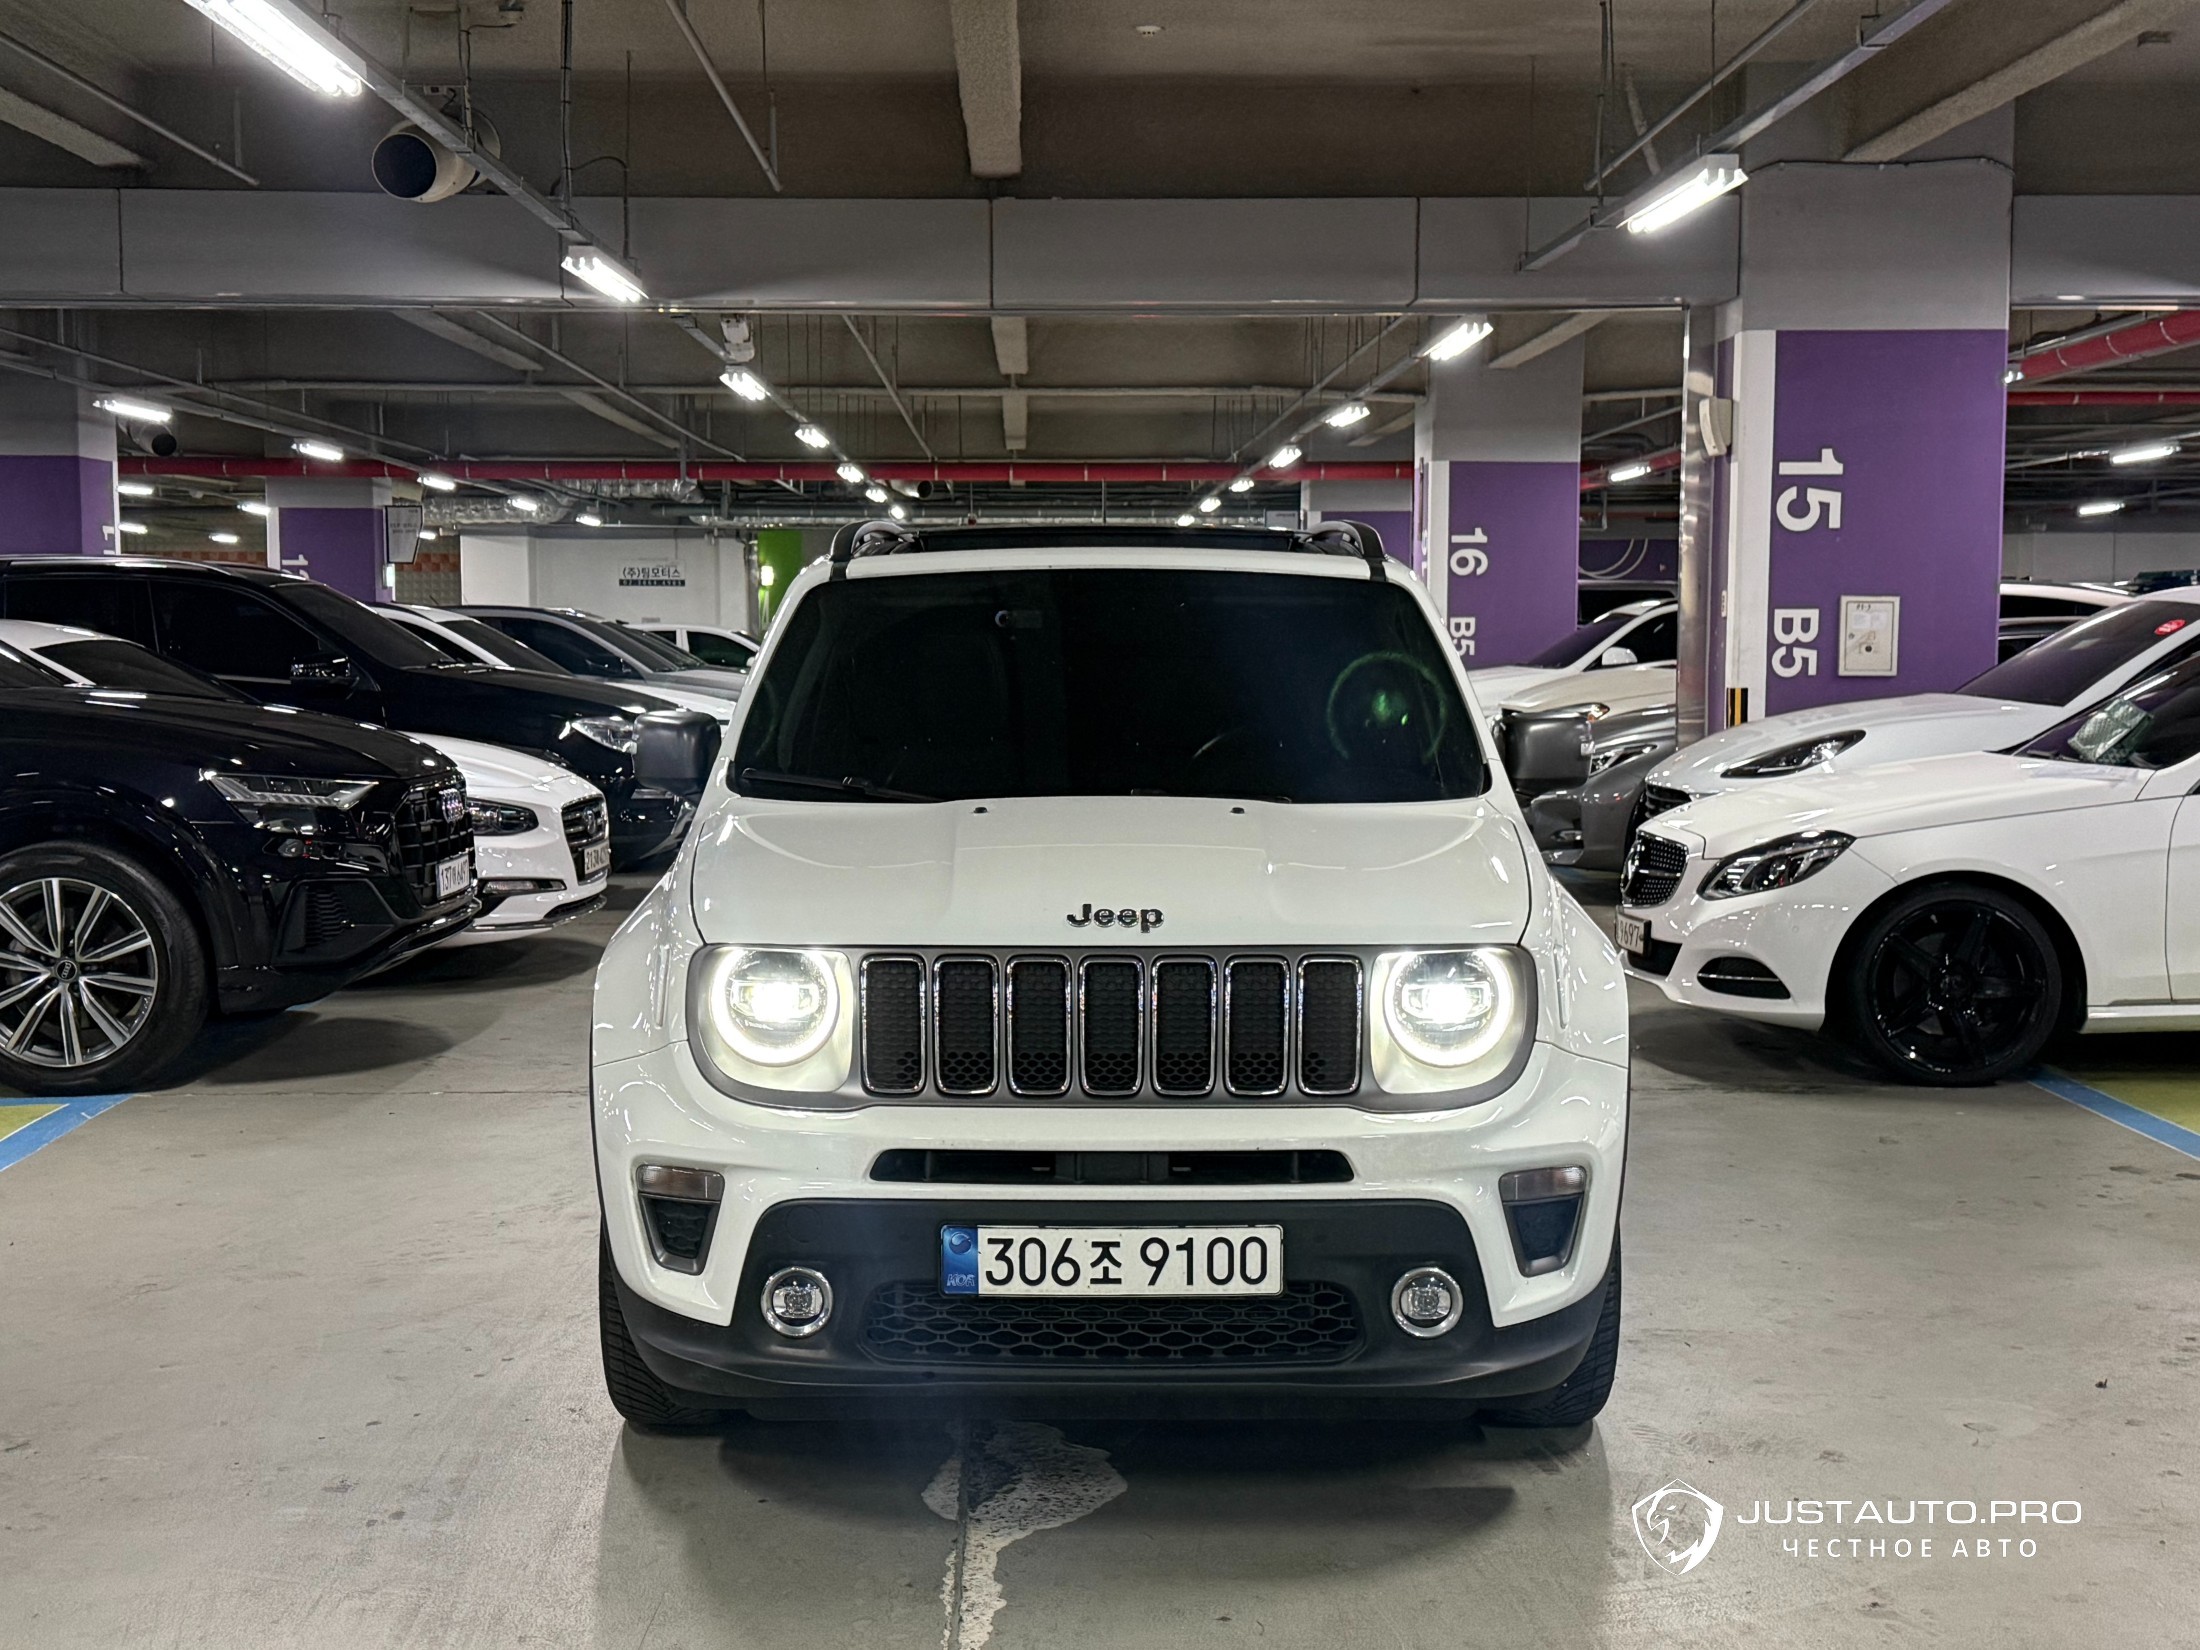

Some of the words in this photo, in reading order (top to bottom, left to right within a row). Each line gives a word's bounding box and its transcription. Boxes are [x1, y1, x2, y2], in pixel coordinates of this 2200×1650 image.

[1776, 448, 1844, 532] 15
[1450, 527, 1488, 576] 16
[1449, 616, 1476, 657] B5
[1771, 608, 1819, 678] B5
[1066, 903, 1164, 933] Jeep
[946, 1273, 976, 1287] KOR
[985, 1236, 1123, 1287] 306조
[1139, 1236, 1268, 1287] 9100
